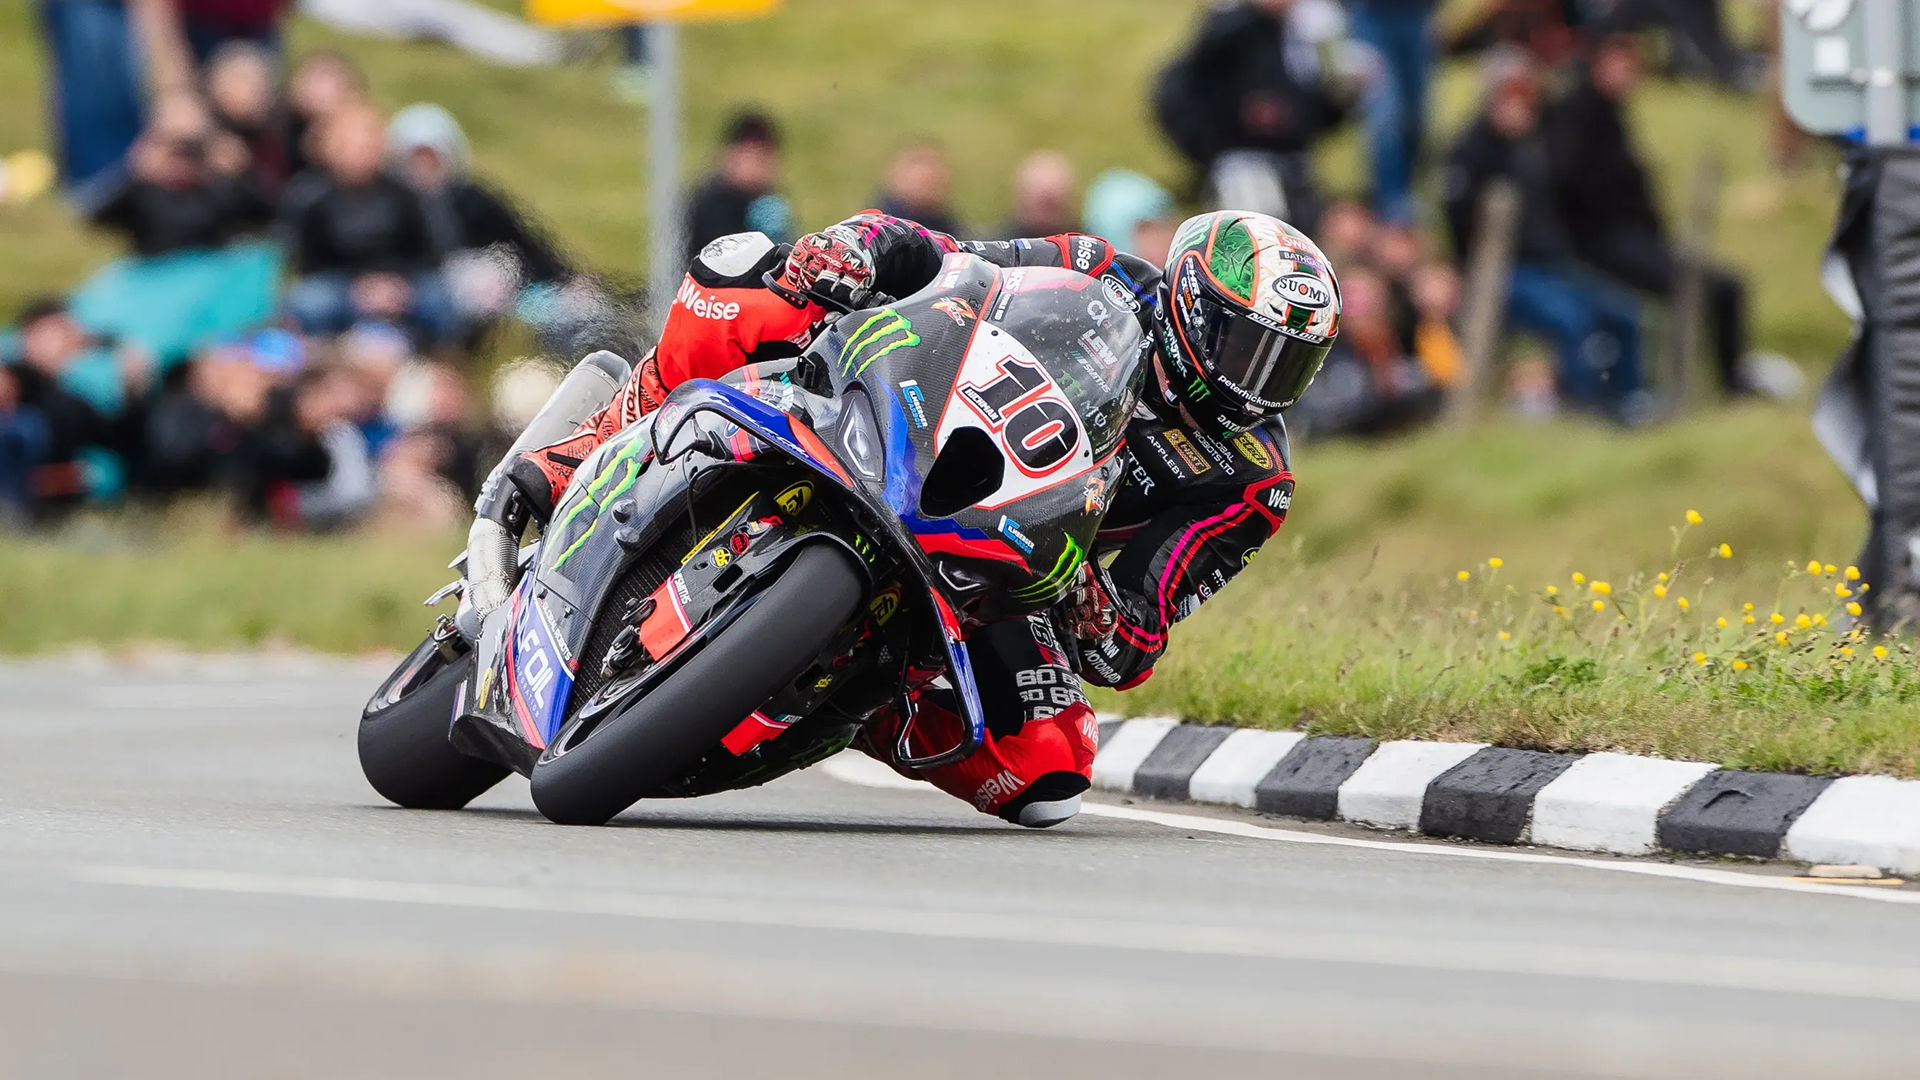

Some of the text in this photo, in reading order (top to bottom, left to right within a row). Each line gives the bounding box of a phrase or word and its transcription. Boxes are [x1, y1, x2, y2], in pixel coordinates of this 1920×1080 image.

[678, 278, 740, 320] Weise
[1279, 277, 1329, 304] SUOMY
[1248, 312, 1299, 335] NOLAN
[1299, 331, 1326, 343] OILS
[1083, 363, 1111, 393] SMITHS
[1218, 375, 1294, 408] peterhickman.net
[958, 357, 1082, 475] 10
[964, 388, 999, 421] HICKMAN
[1147, 435, 1186, 480] APPLEBY
[1193, 430, 1236, 477] ROBOTS LTD
[1127, 446, 1155, 496] TER
[554, 628, 573, 661] ROBOTS
[1016, 669, 1057, 687] 60
